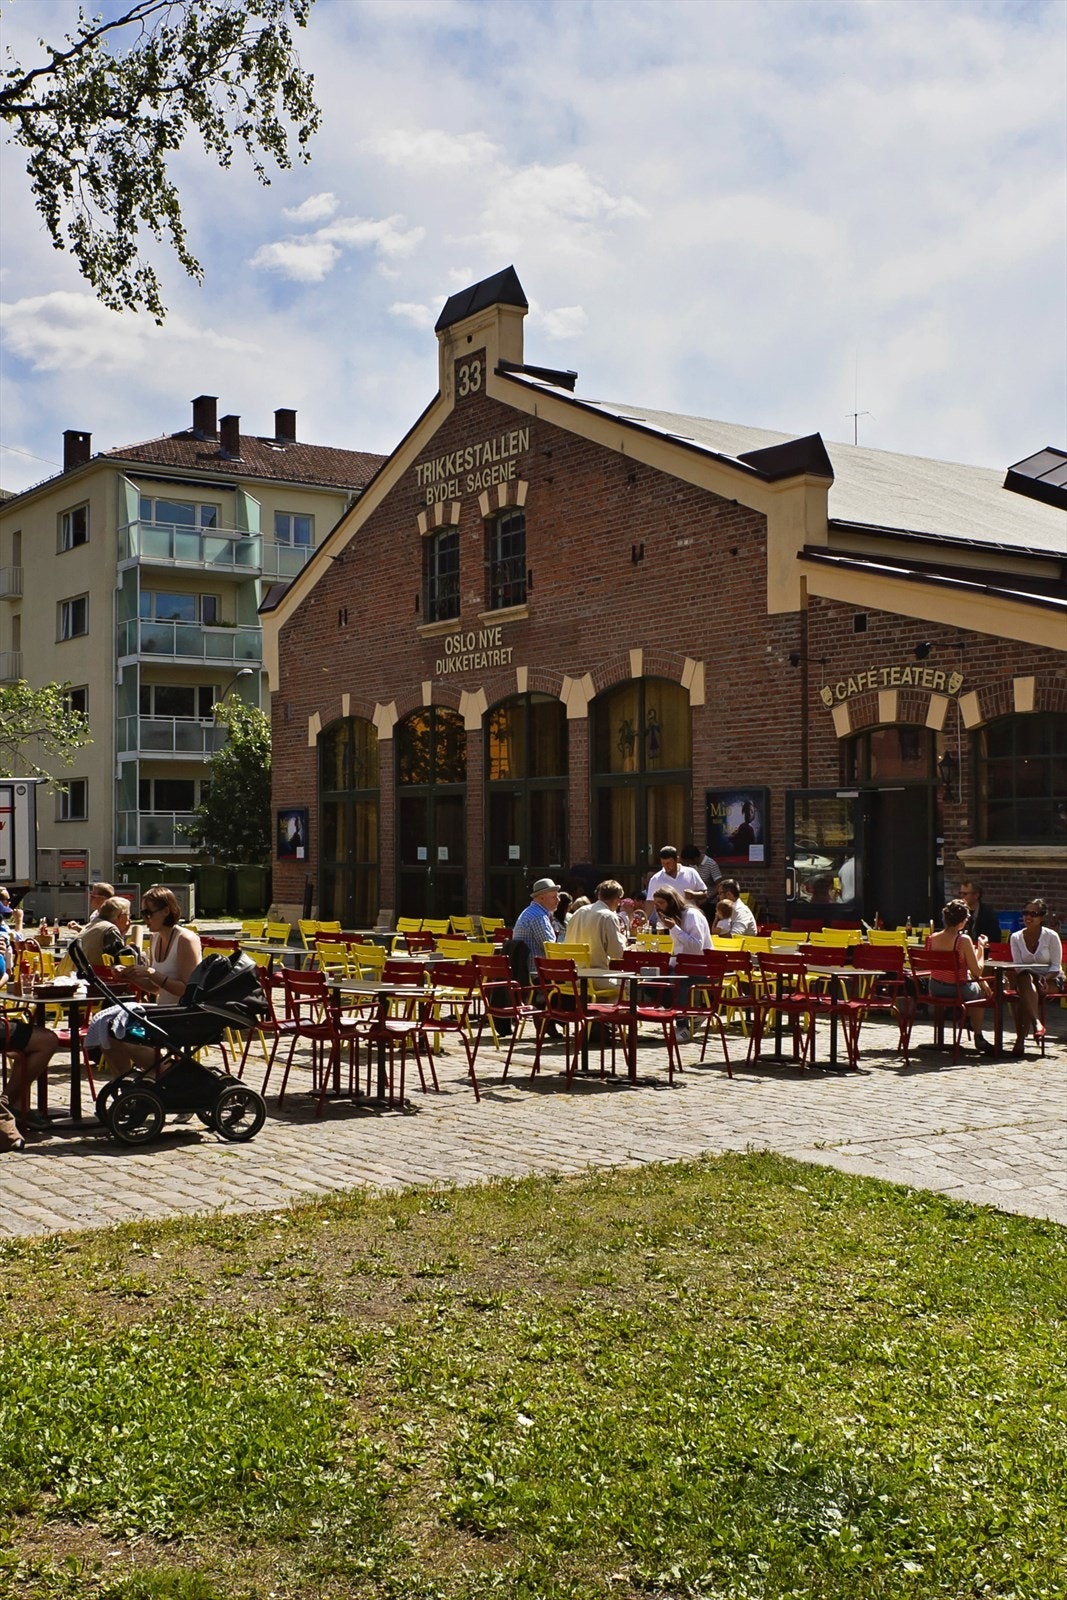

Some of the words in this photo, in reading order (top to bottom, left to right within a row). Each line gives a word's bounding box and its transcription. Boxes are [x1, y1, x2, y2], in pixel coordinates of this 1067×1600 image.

[458, 360, 482, 397] 33
[415, 427, 530, 487] TRIKKESTALLEN
[426, 477, 462, 506] BYDEL
[466, 460, 516, 493] SAGENE
[444, 631, 476, 655] OSLO
[479, 627, 502, 649] NYE
[435, 647, 513, 675] DUKKETEATRET
[835, 665, 878, 700] CAFÉ
[880, 666, 946, 691] TEATER
[710, 802, 733, 817] Mio
